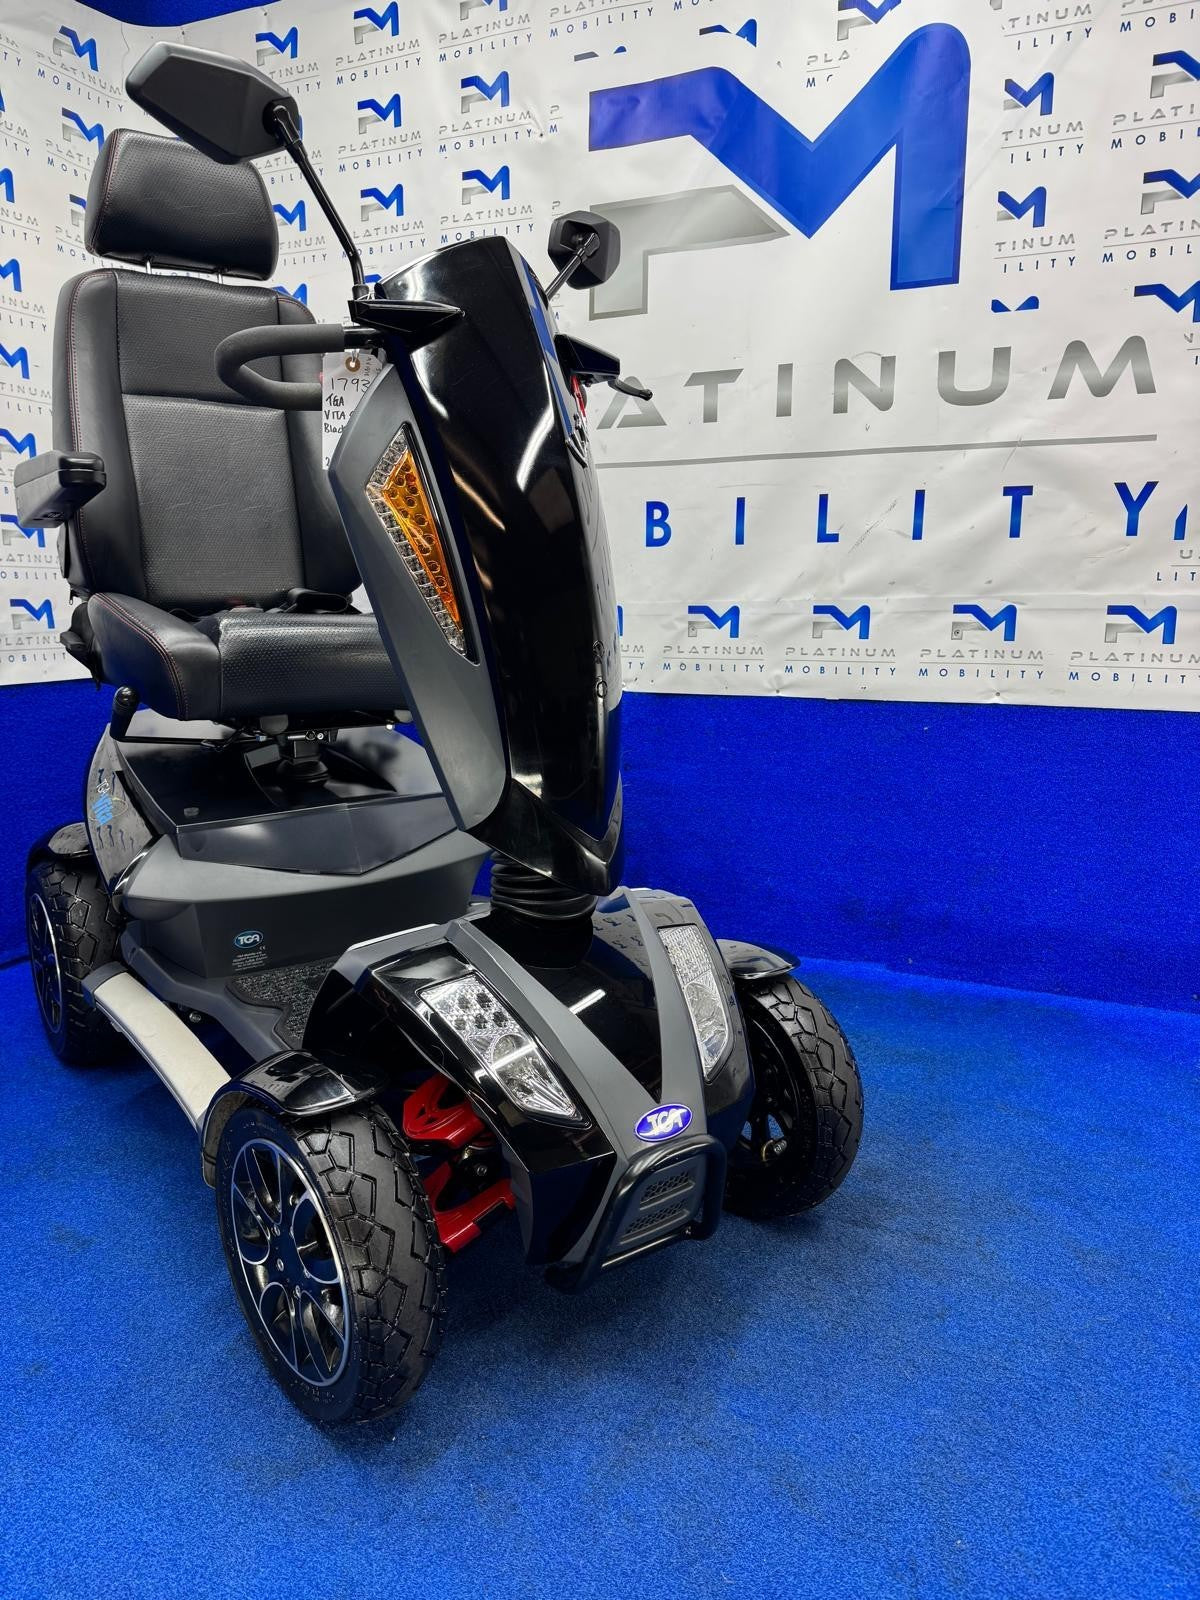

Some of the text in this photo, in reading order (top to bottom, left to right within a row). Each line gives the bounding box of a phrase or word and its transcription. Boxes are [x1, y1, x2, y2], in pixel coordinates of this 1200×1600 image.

[438, 13, 532, 44] PLATINUM
[550, 7, 654, 38] MOBILITY
[335, 38, 421, 67] PLATINUM
[438, 33, 532, 63] MOBILITY
[34, 50, 122, 96] PLATINUM
[336, 56, 422, 86] MOBILITY
[37, 67, 124, 113] MOBILITY
[438, 110, 532, 135] PLATINUM
[45, 140, 96, 166] PLATI
[337, 130, 422, 155] PLATINUM
[438, 129, 532, 154] MOBILITY
[338, 147, 423, 174] MOBILITY
[440, 203, 533, 226] PLATINUM
[662, 645, 765, 656] PLATINUM
[785, 646, 897, 658] PLATINUM
[919, 648, 1044, 661] PLATINUM
[662, 662, 766, 673] MOBILITY
[784, 665, 897, 677] MOBILITY
[918, 667, 1045, 679] MOBILITY
[1068, 671, 1200, 684] MOBILIT
[237, 933, 260, 945] TGA
